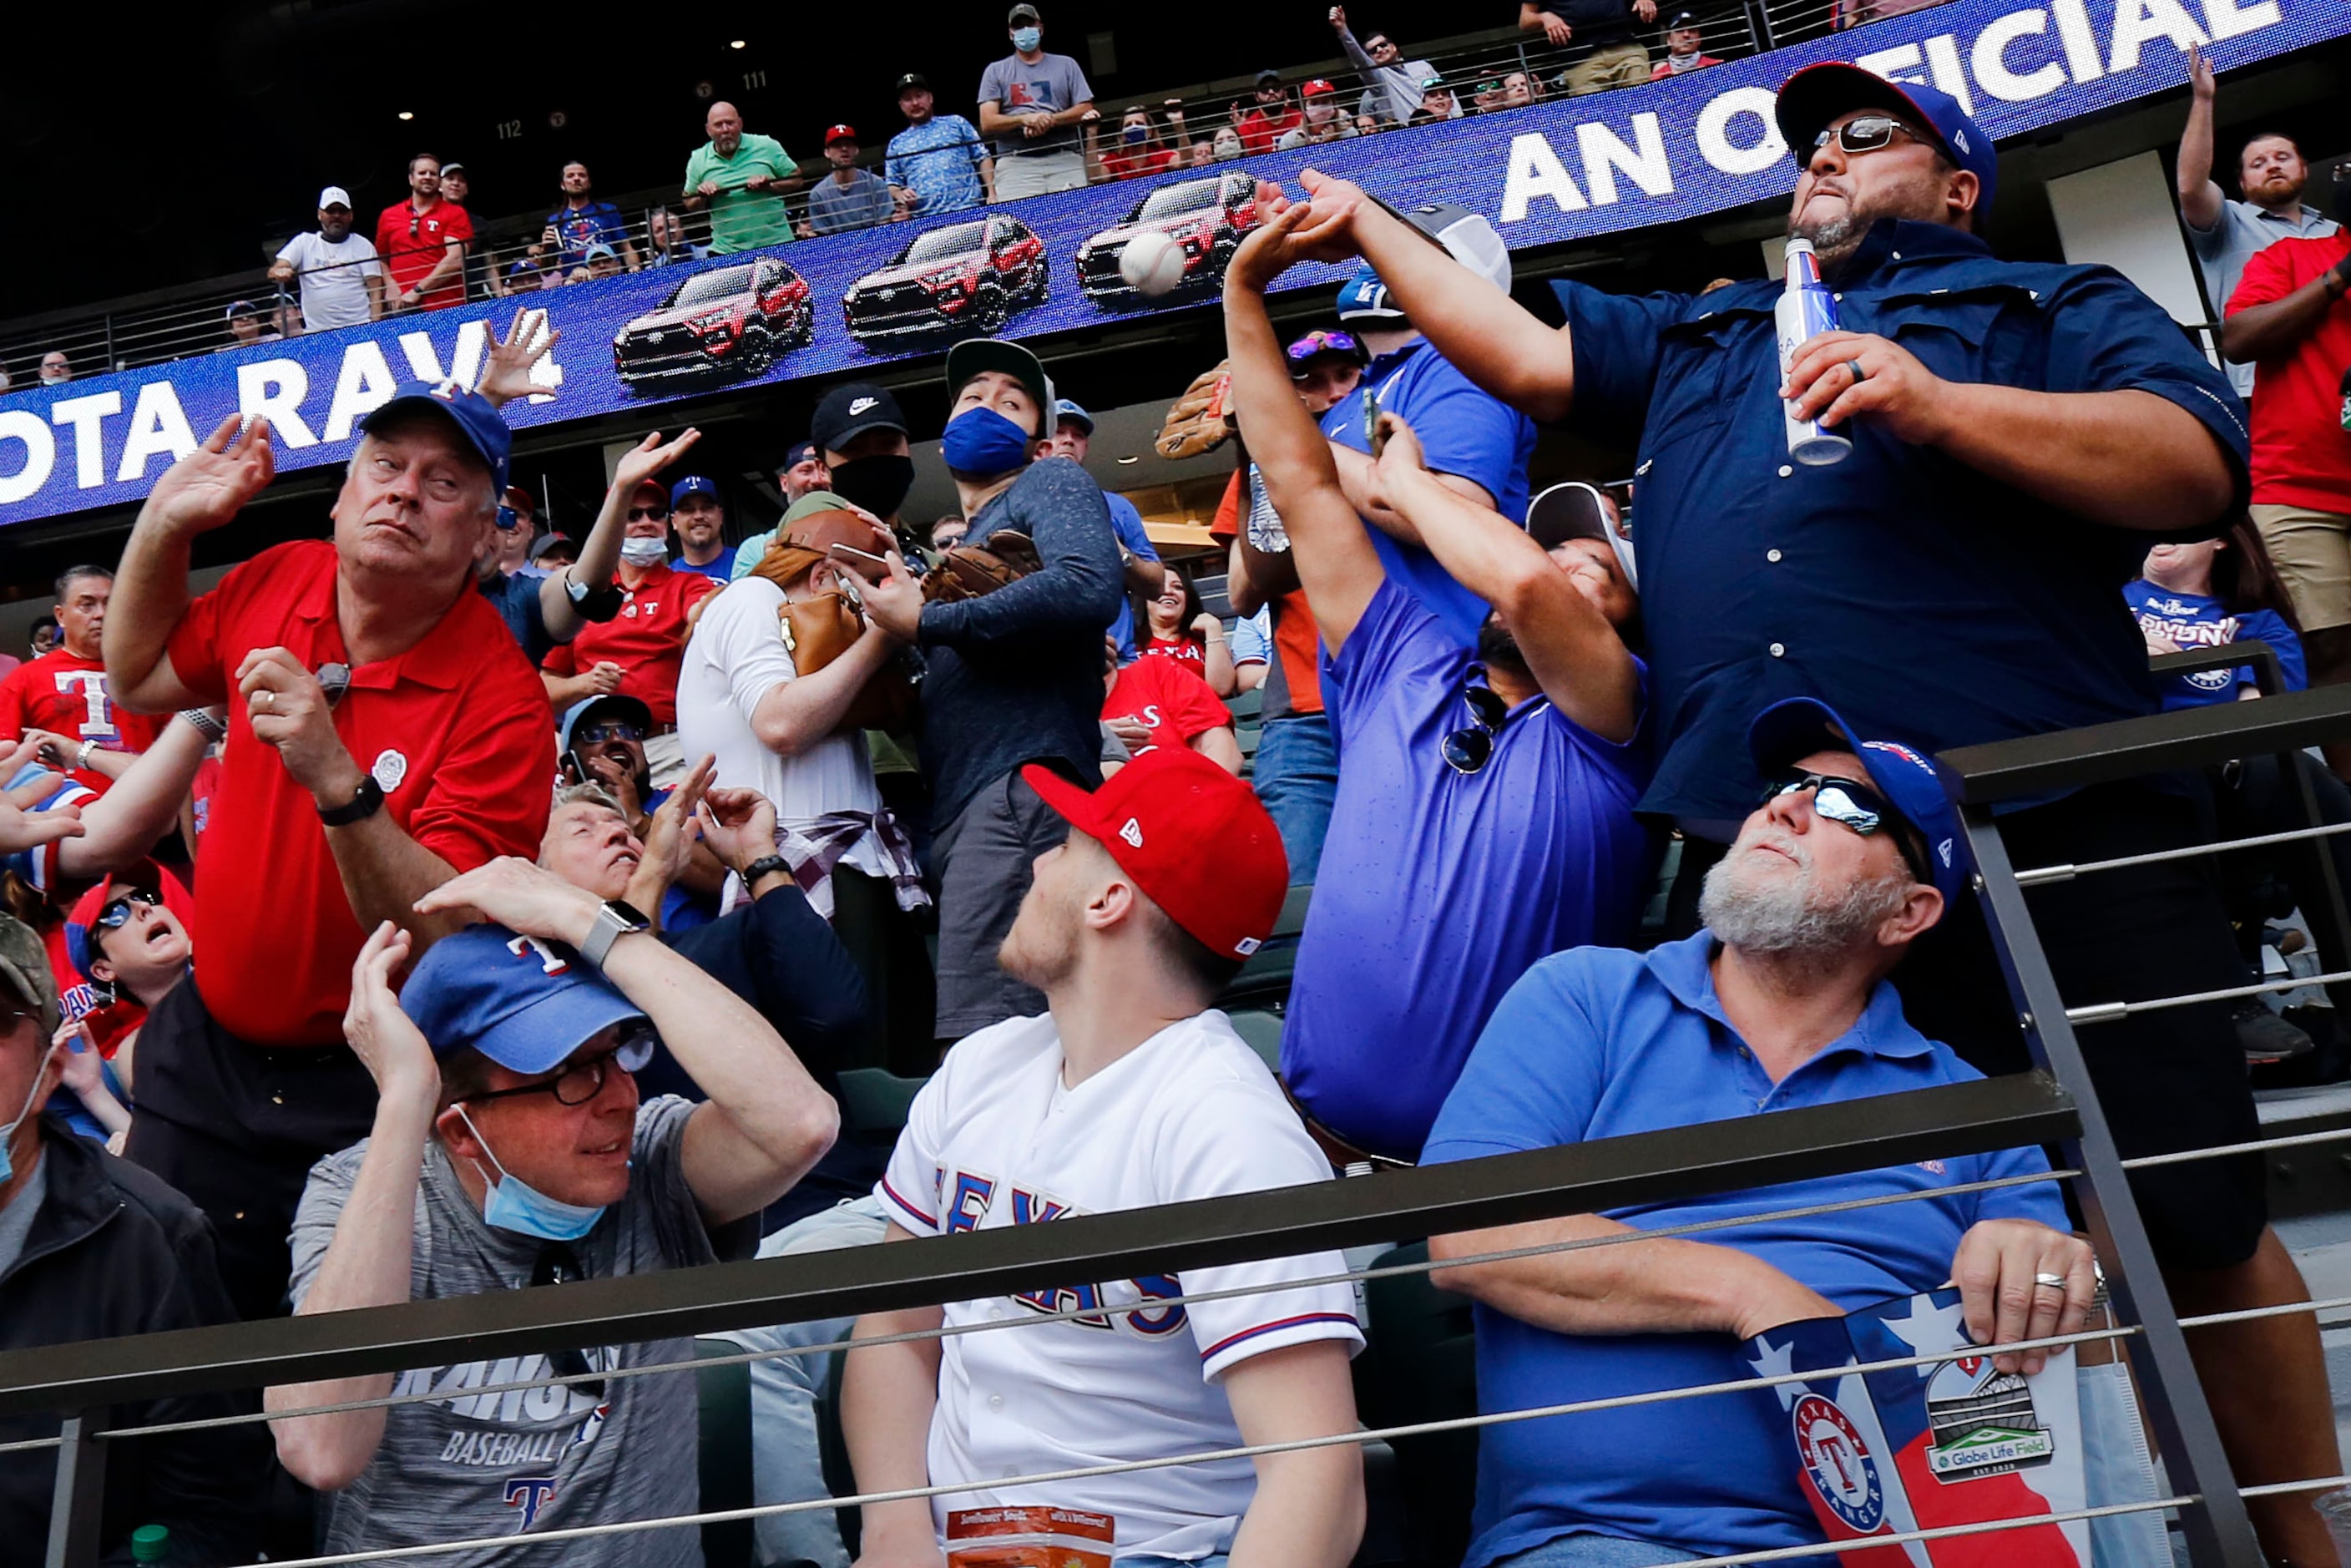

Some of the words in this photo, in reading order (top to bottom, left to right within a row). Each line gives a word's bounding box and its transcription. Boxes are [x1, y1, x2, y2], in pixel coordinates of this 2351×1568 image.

[742, 69, 766, 90] 111
[497, 119, 522, 139] 112
[1501, 112, 1676, 223] AN
[1696, 0, 2284, 175] OICIAL
[644, 601, 659, 615] T
[53, 670, 123, 741] T
[506, 934, 571, 978] T
[1798, 1402, 1848, 1438] TEXAS
[439, 1430, 555, 1466] BASEBALL
[1816, 1435, 1858, 1495] T
[1952, 1449, 1989, 1465] Globe
[1990, 1444, 2015, 1459] Life
[2015, 1439, 2045, 1455] Field
[1817, 1469, 1880, 1525] RANGERS
